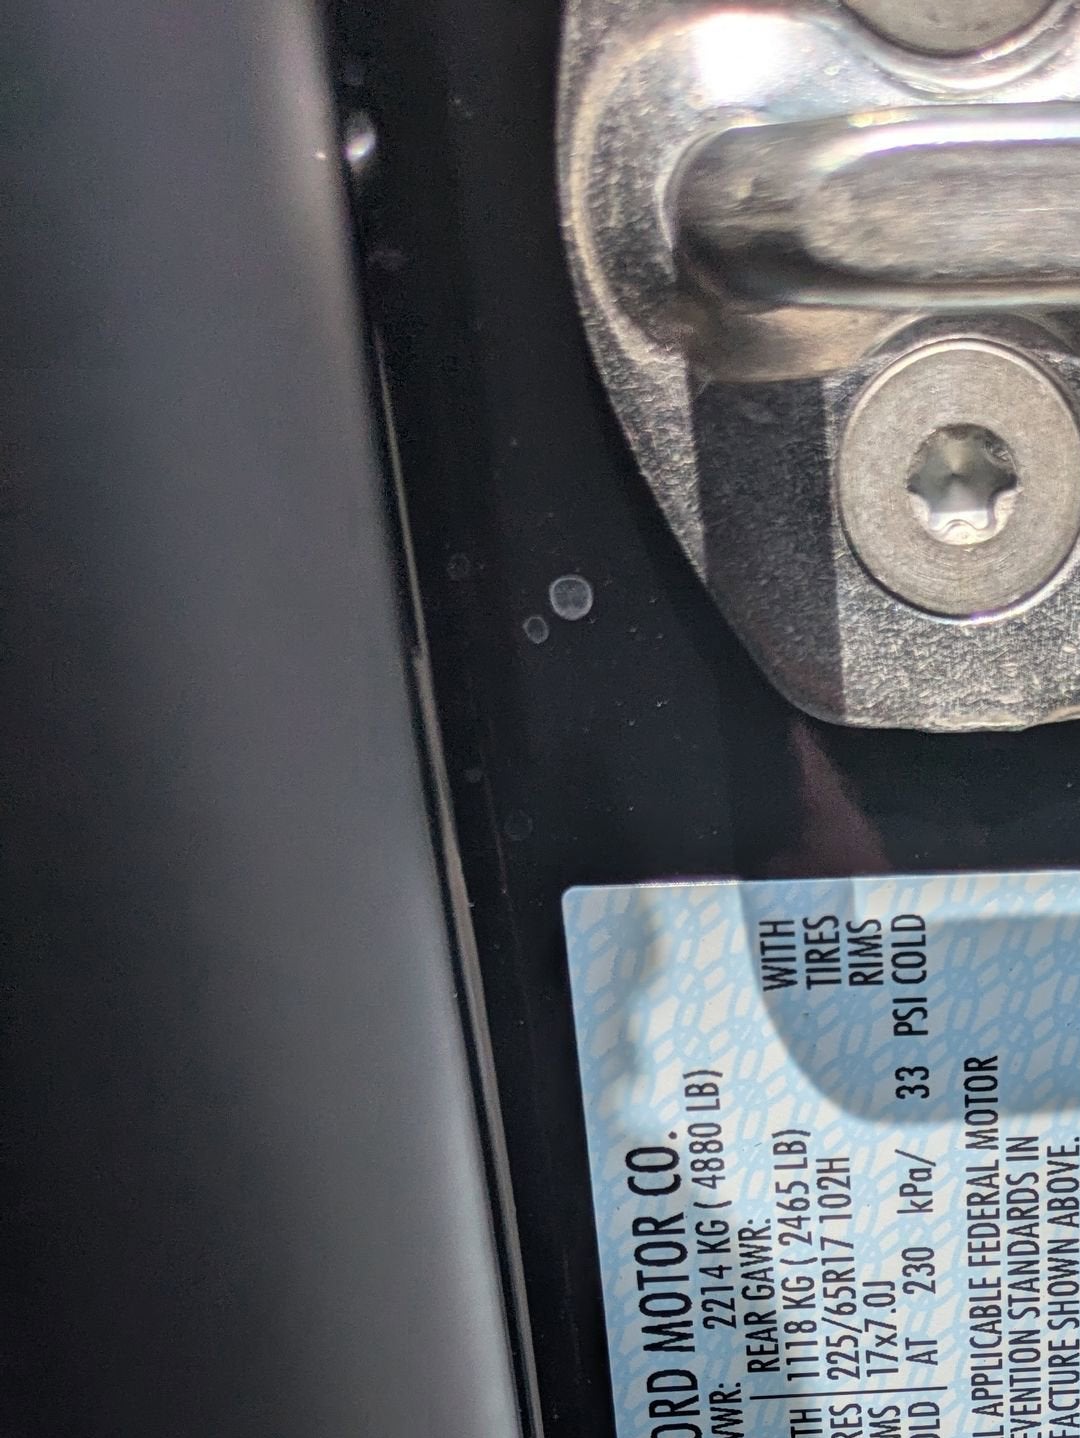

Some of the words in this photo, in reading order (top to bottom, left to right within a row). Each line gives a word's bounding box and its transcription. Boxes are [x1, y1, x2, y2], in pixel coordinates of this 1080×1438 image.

[758, 920, 798, 992] WITH
[802, 915, 842, 991] TIRES
[847, 919, 884, 987] RIMS
[890, 914, 928, 985] COLD
[891, 997, 929, 1037] PSI
[685, 1069, 723, 1112] LB)
[894, 1066, 930, 1100] 33
[962, 1055, 999, 1150] MOTOR
[625, 1131, 682, 1197] CO.
[688, 1122, 726, 1190] 4880
[772, 1129, 811, 1170] LB)
[894, 1148, 937, 1214] kPa/
[1005, 1136, 1040, 1162] IN
[1046, 1136, 1080, 1229] ABOVE.
[775, 1180, 813, 1246] 2465
[815, 1157, 853, 1224] 102H
[965, 1159, 1001, 1267] FEDERAL
[694, 1219, 731, 1255] KG
[738, 1218, 776, 1302] GAWR:
[900, 1246, 936, 1295] 230
[1005, 1171, 1041, 1320] STANDARDS
[631, 1211, 696, 1353] MOTOR
[698, 1264, 737, 1330] 2214
[780, 1275, 816, 1310] KG
[819, 1236, 863, 1381] 225/65R17
[1046, 1238, 1080, 1331] SHOWN
[743, 1310, 781, 1373] REAR
[783, 1319, 820, 1382] 1118
[862, 1280, 899, 1378] 17x7.0J
[904, 1337, 939, 1366] AT
[968, 1276, 1004, 1418] APPLICABLE
